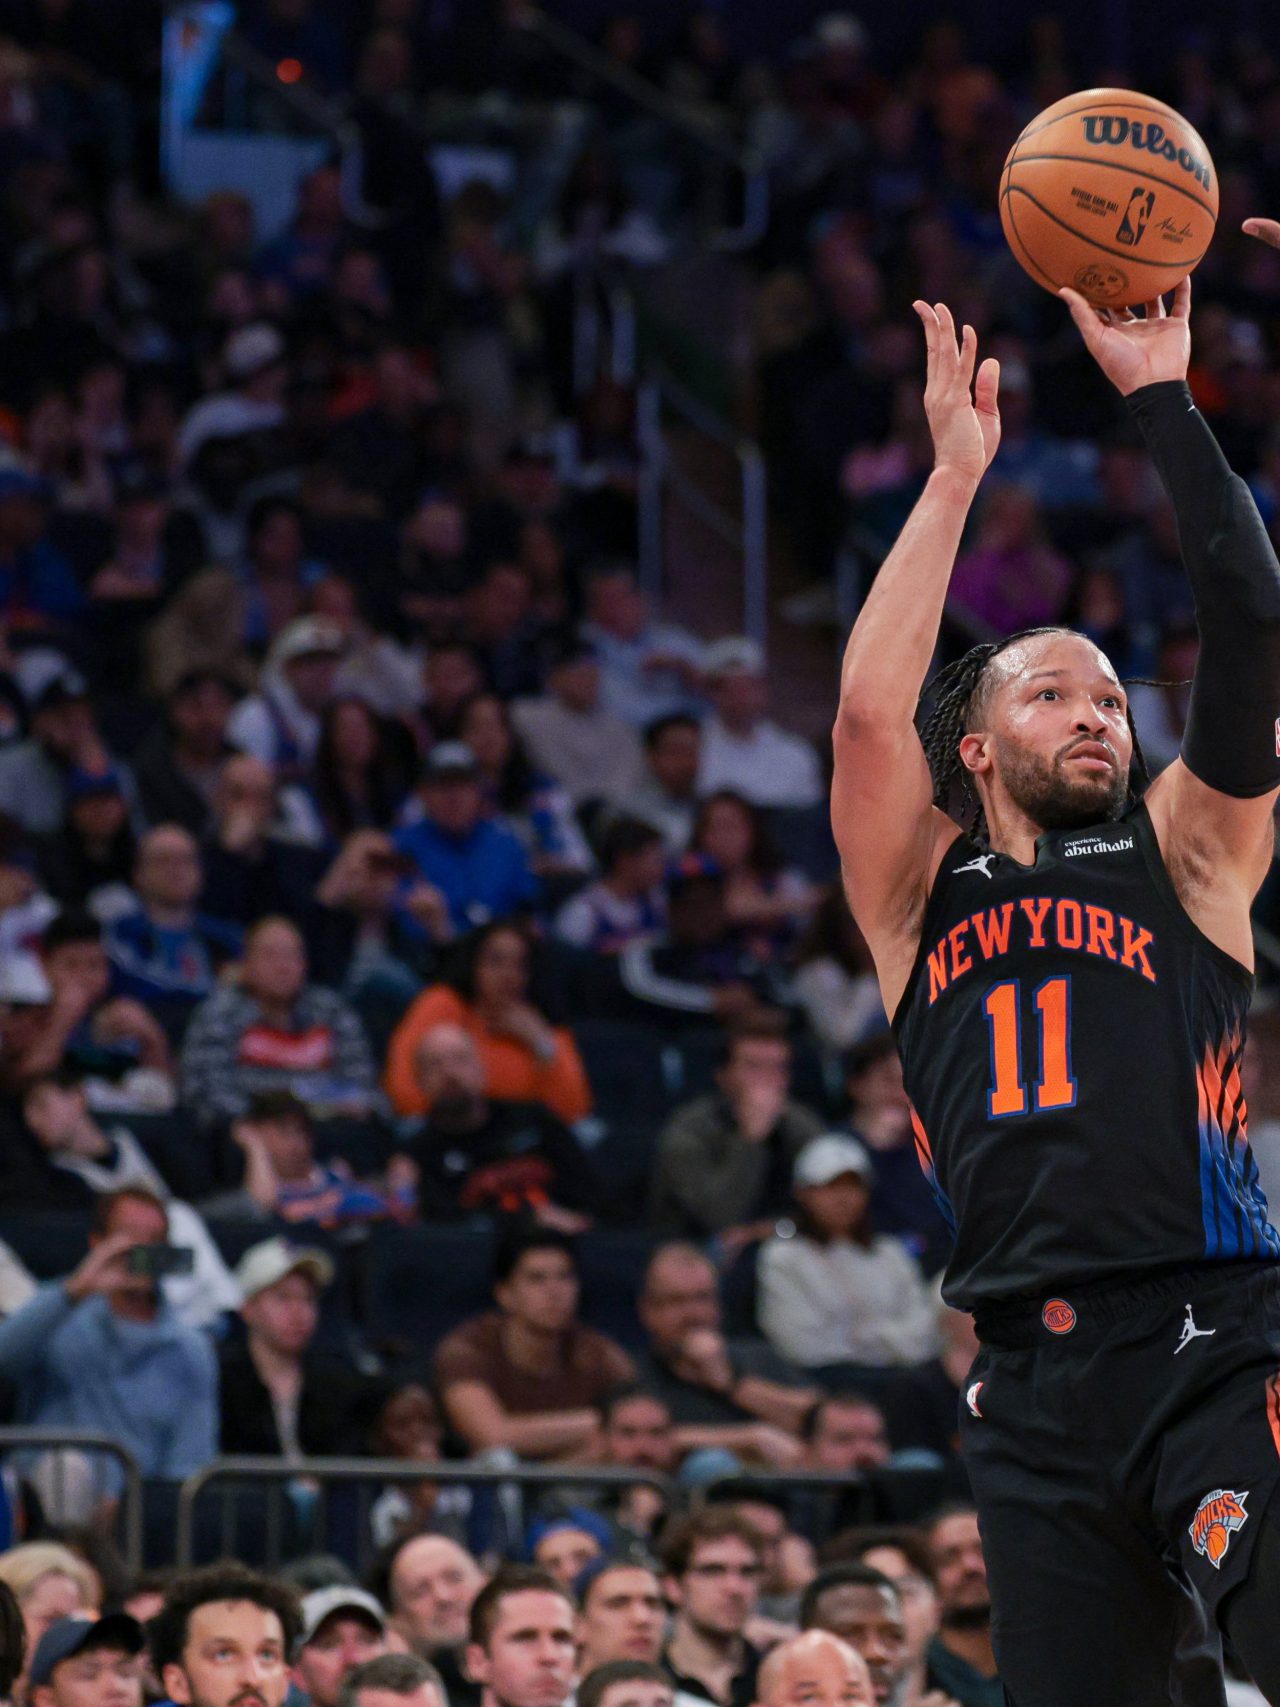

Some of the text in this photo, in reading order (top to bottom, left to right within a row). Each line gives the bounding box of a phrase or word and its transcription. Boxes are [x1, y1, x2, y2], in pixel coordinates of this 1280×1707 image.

[1082, 115, 1210, 193] Wilson
[1064, 837, 1102, 847] experience
[1064, 836, 1134, 857] abu dhabi
[927, 897, 1157, 1007] NEW YORK
[981, 973, 1078, 1121] 11
[1193, 1493, 1246, 1547] KNICKS
